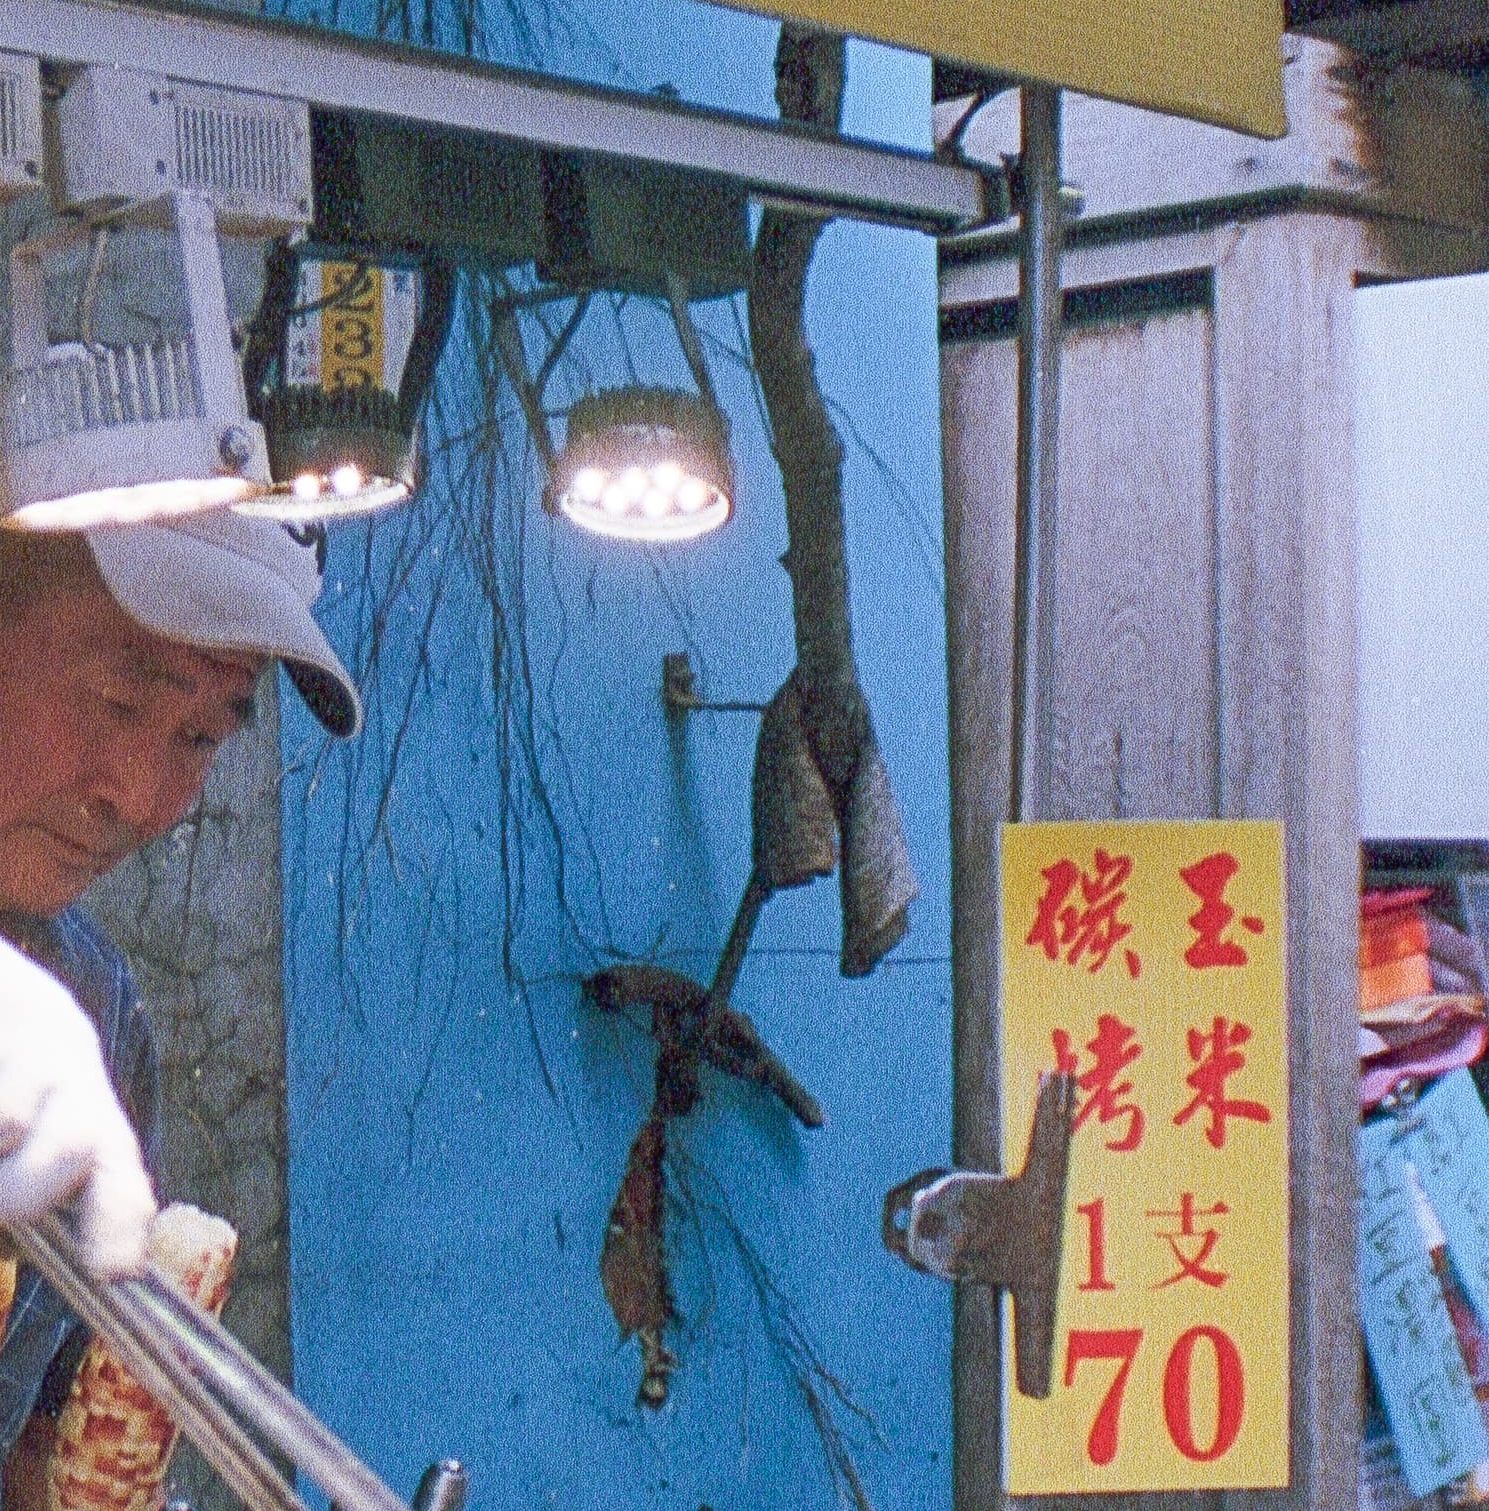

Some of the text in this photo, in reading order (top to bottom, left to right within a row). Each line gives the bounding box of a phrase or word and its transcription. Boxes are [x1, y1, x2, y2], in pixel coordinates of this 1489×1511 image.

[1173, 850, 1272, 1151] 玉米
[1076, 1192, 1229, 1292] 1支
[1063, 1324, 1246, 1466] 70
